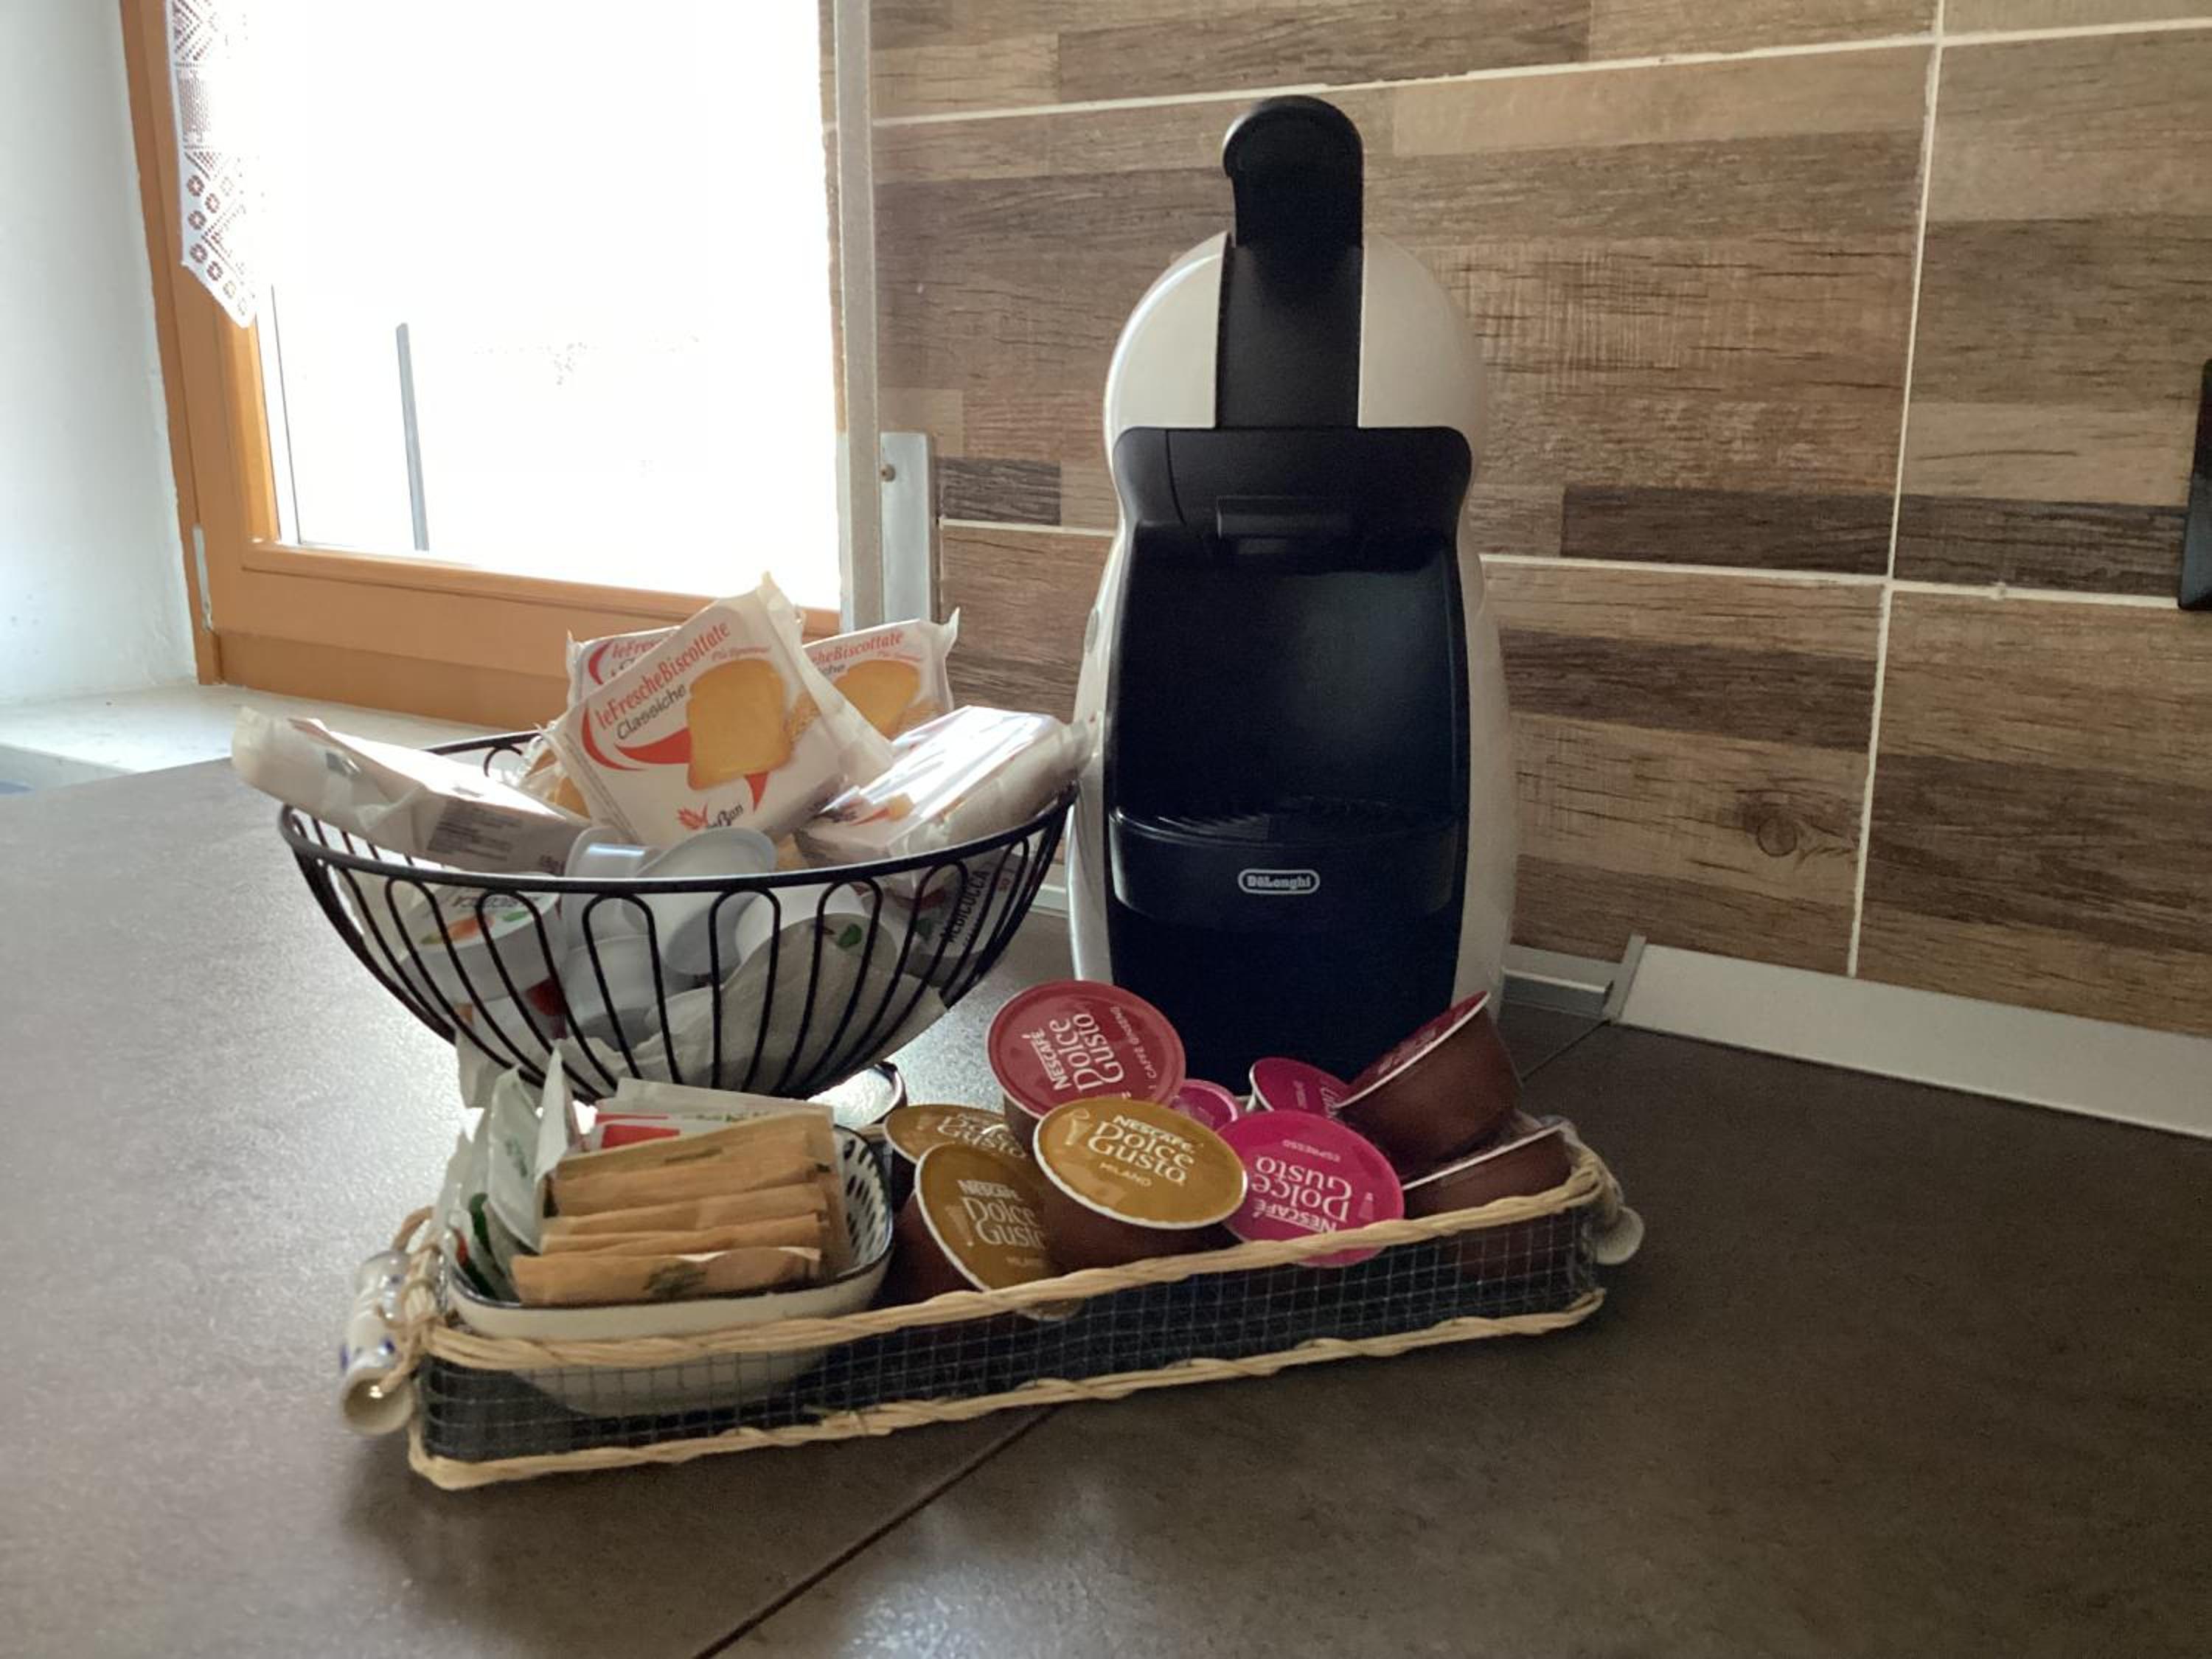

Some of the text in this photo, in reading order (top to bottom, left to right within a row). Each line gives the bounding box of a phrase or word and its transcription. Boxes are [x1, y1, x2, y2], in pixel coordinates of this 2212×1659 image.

[616, 683, 687, 740] Classiche
[1049, 1018, 1106, 1093] Dolce
[1073, 1014, 1124, 1084] Gusto
[1088, 1135, 1187, 1186] Gusto
[1094, 1121, 1195, 1169] Dolce
[1251, 1173, 1349, 1222] Dolce
[1256, 1155, 1352, 1201] Gusto
[962, 1196, 1041, 1228] Dolce
